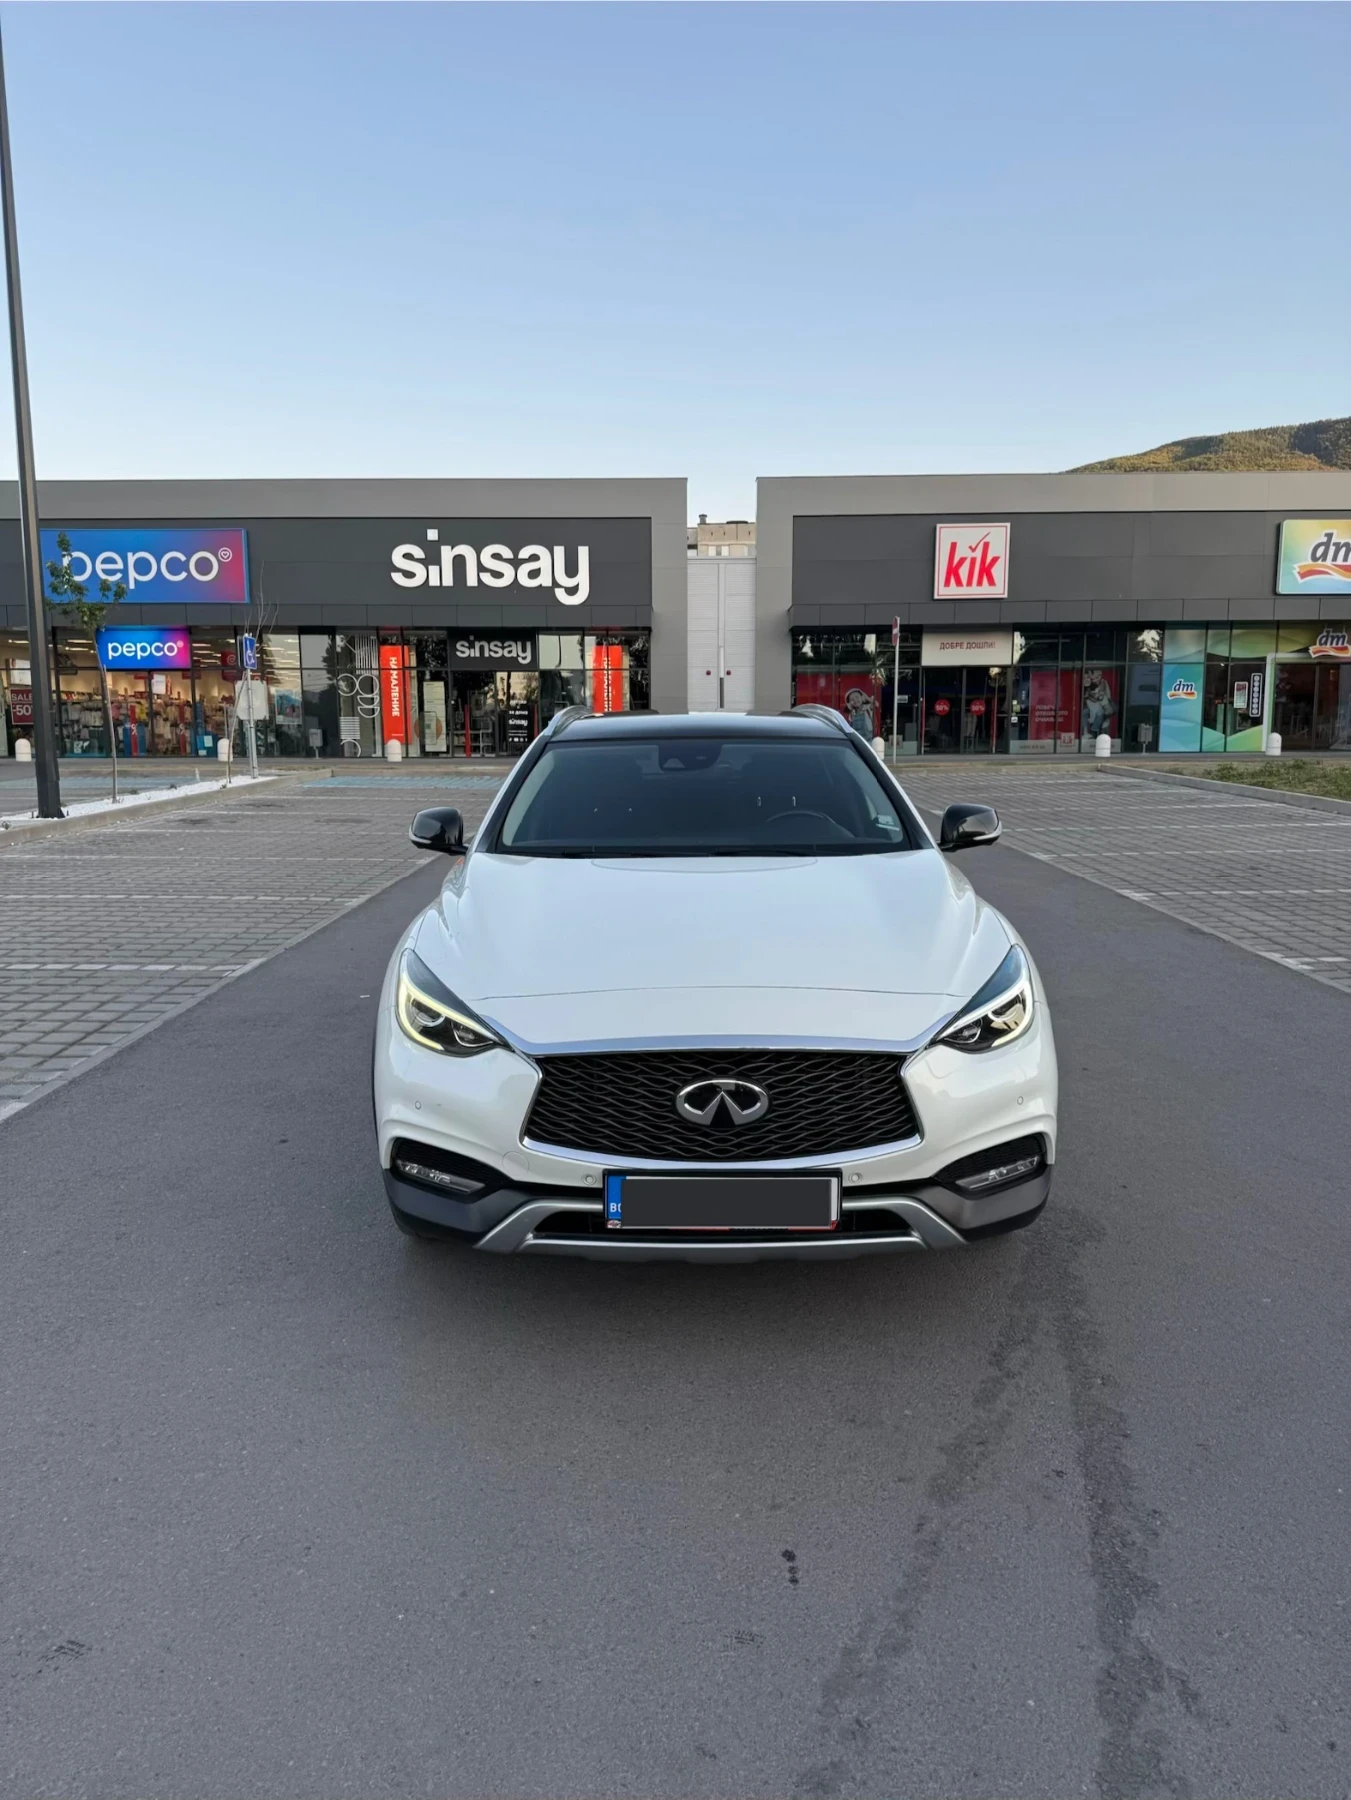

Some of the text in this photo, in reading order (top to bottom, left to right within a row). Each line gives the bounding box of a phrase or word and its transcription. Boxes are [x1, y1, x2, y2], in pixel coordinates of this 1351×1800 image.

[61, 551, 219, 589] pepco
[390, 529, 590, 606] sinsay
[943, 532, 1001, 588] kik
[455, 635, 533, 665] sinsay
[940, 642, 965, 651] ДОБРЕ
[1317, 630, 1347, 647] dm
[107, 642, 178, 660] pepco
[1173, 680, 1195, 692] dm
